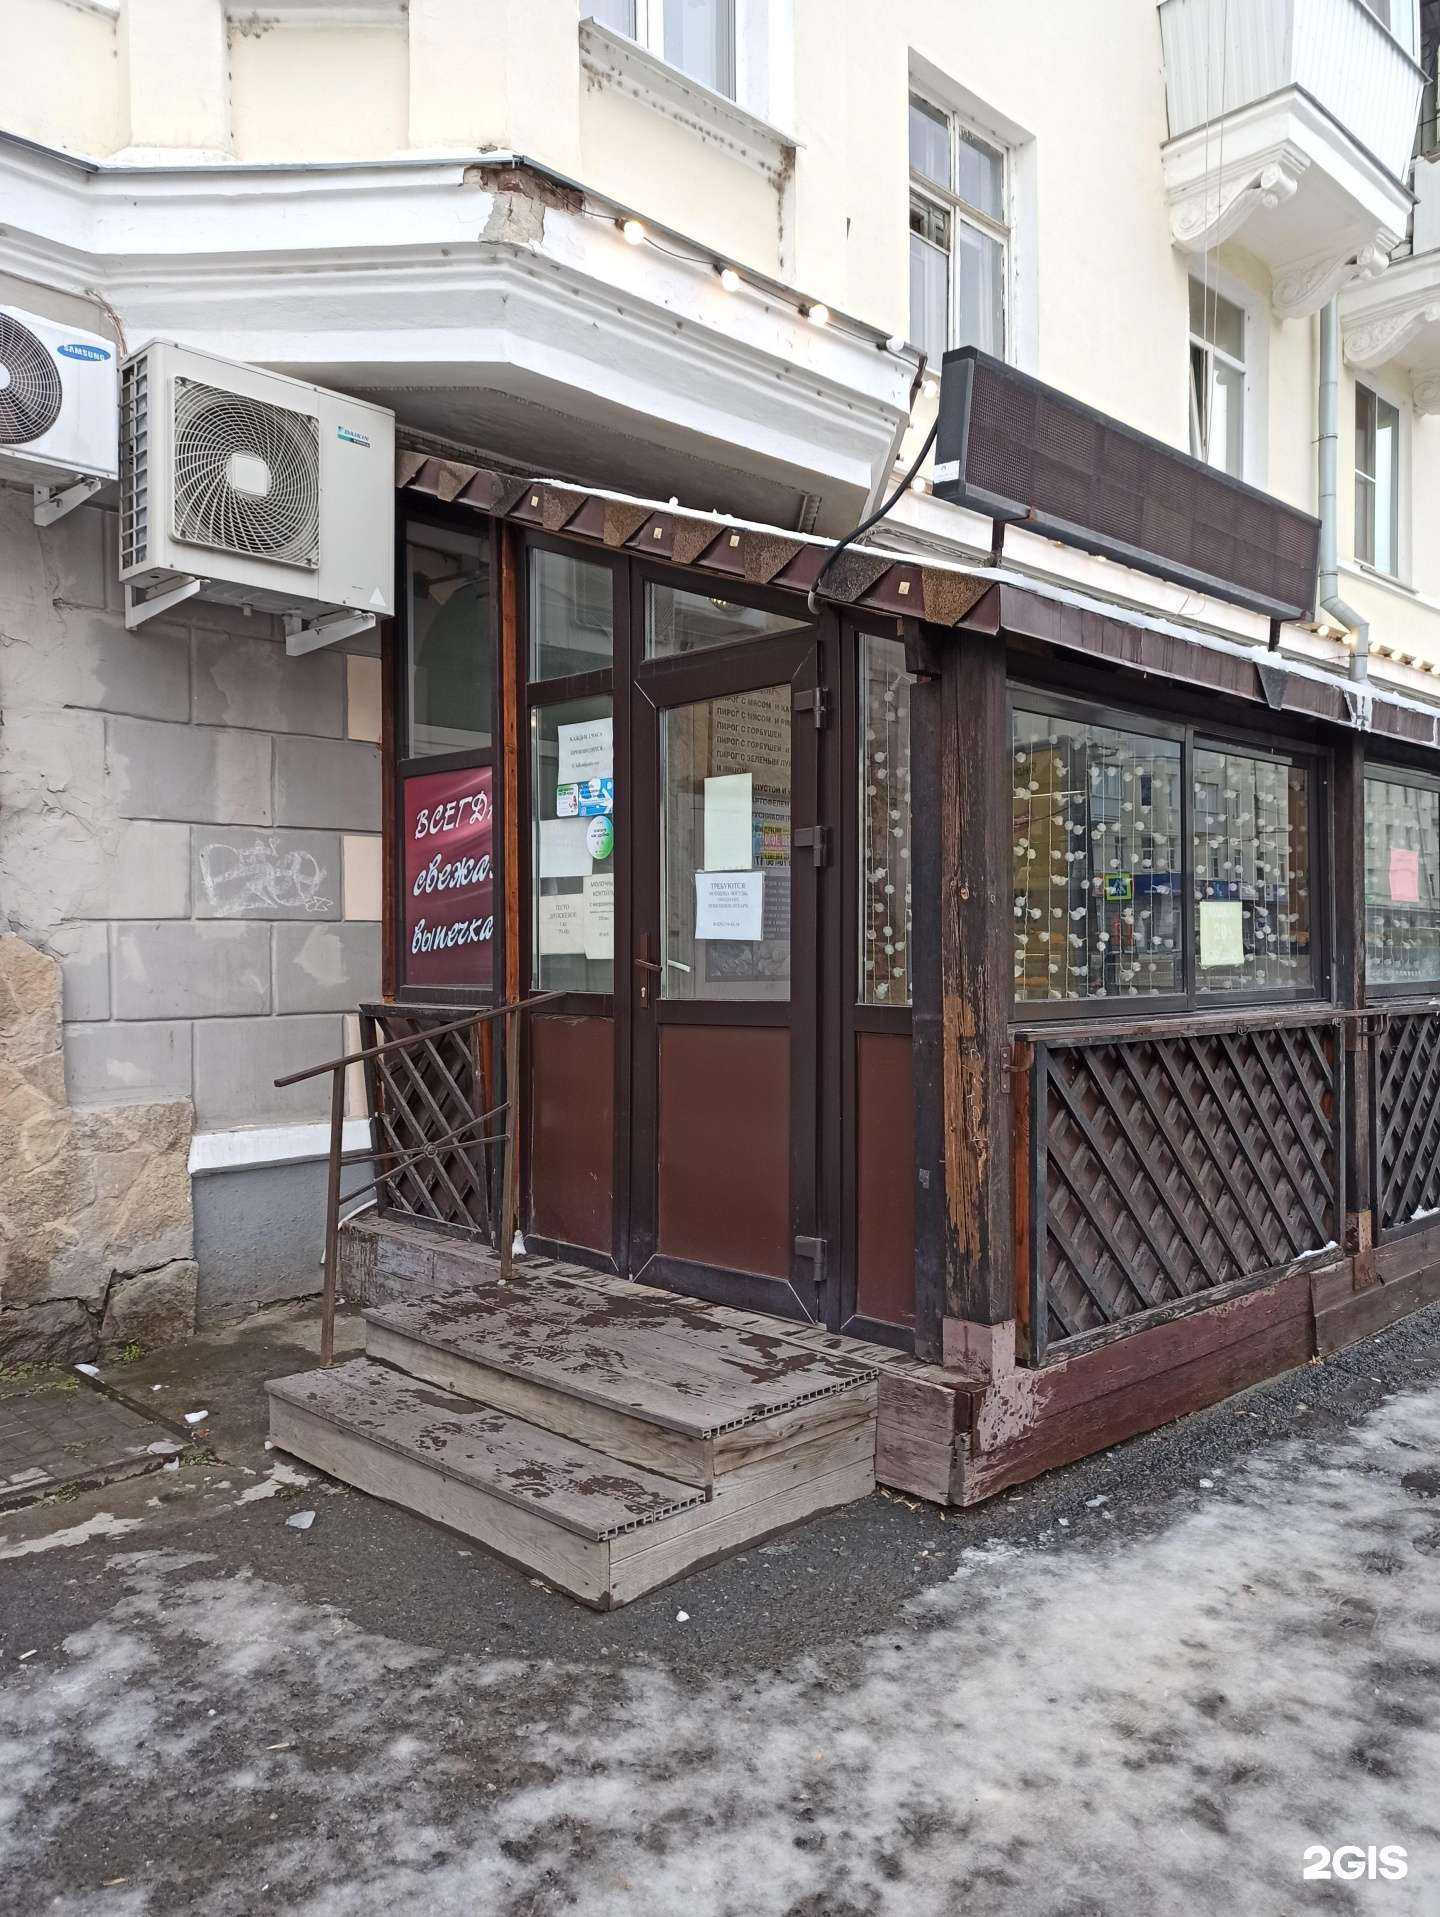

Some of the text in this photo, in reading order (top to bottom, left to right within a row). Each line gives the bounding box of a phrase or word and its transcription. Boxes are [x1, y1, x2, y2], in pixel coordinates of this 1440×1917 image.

[63, 345, 105, 361] SAMSUNG
[717, 707, 739, 718] ПИРОГ
[741, 711, 746, 719] С
[716, 721, 739, 731] ПИРОГ
[740, 725, 746, 733] С
[716, 736, 739, 746] ПИРОГ
[716, 750, 739, 760] ПИРОГ
[415, 791, 493, 839] ВСЕГД
[413, 853, 493, 896] свежа
[411, 915, 494, 954] выпечка
